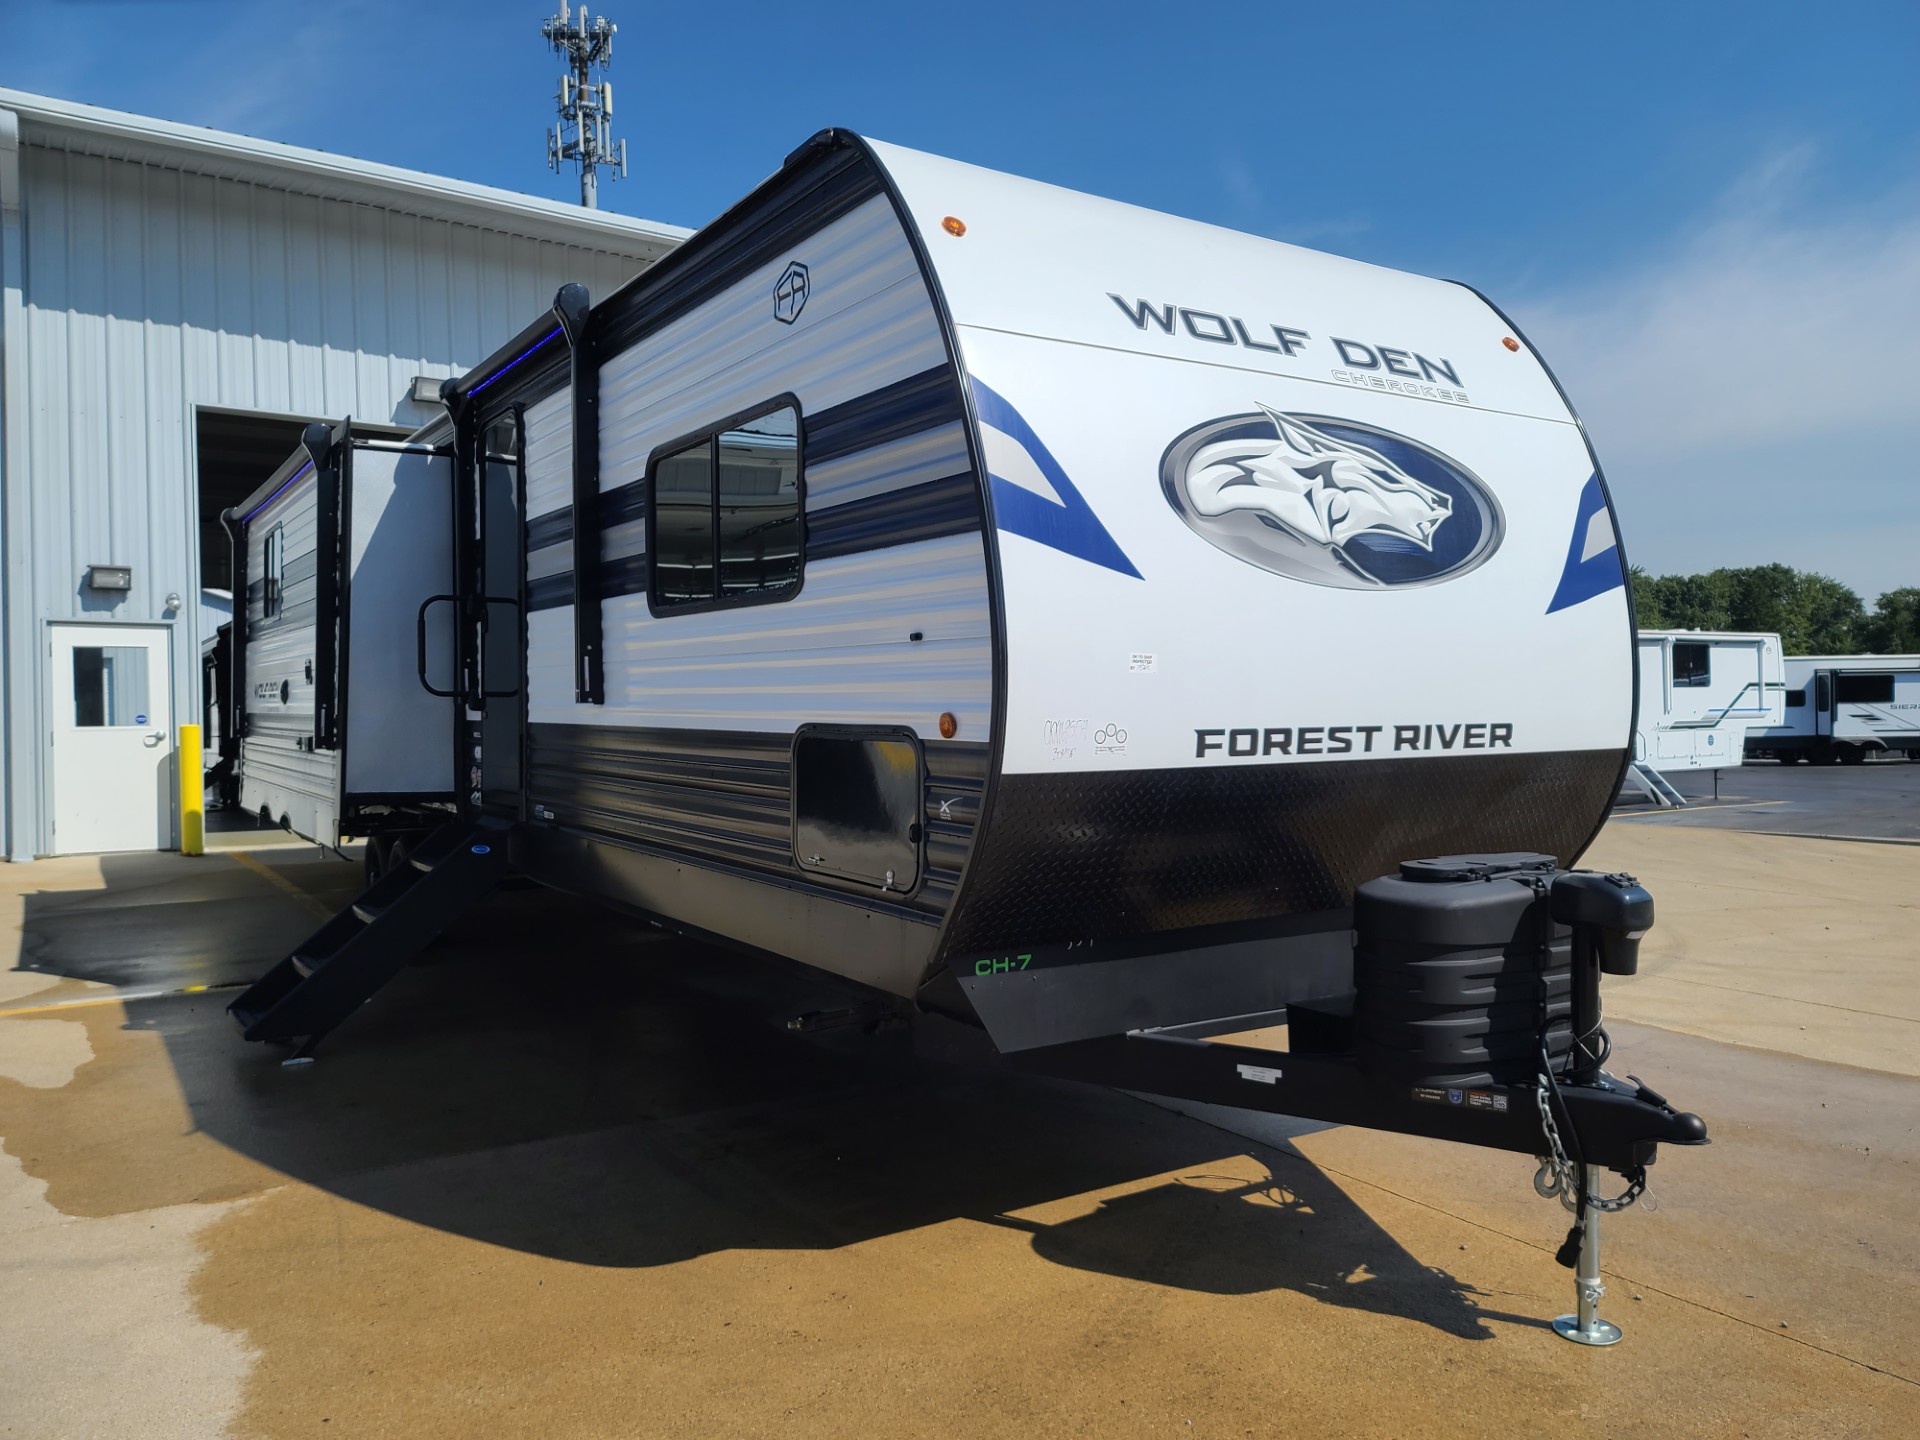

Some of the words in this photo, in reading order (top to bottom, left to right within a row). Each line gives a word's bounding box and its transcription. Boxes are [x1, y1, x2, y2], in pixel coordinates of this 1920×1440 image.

[1105, 292, 1312, 357] WOLF
[1329, 336, 1464, 388] DEN
[1330, 369, 1470, 404] CHEROKEE
[1194, 726, 1383, 758] FOREST
[1393, 723, 1514, 751] RIVER
[975, 953, 1032, 976] CH-7
